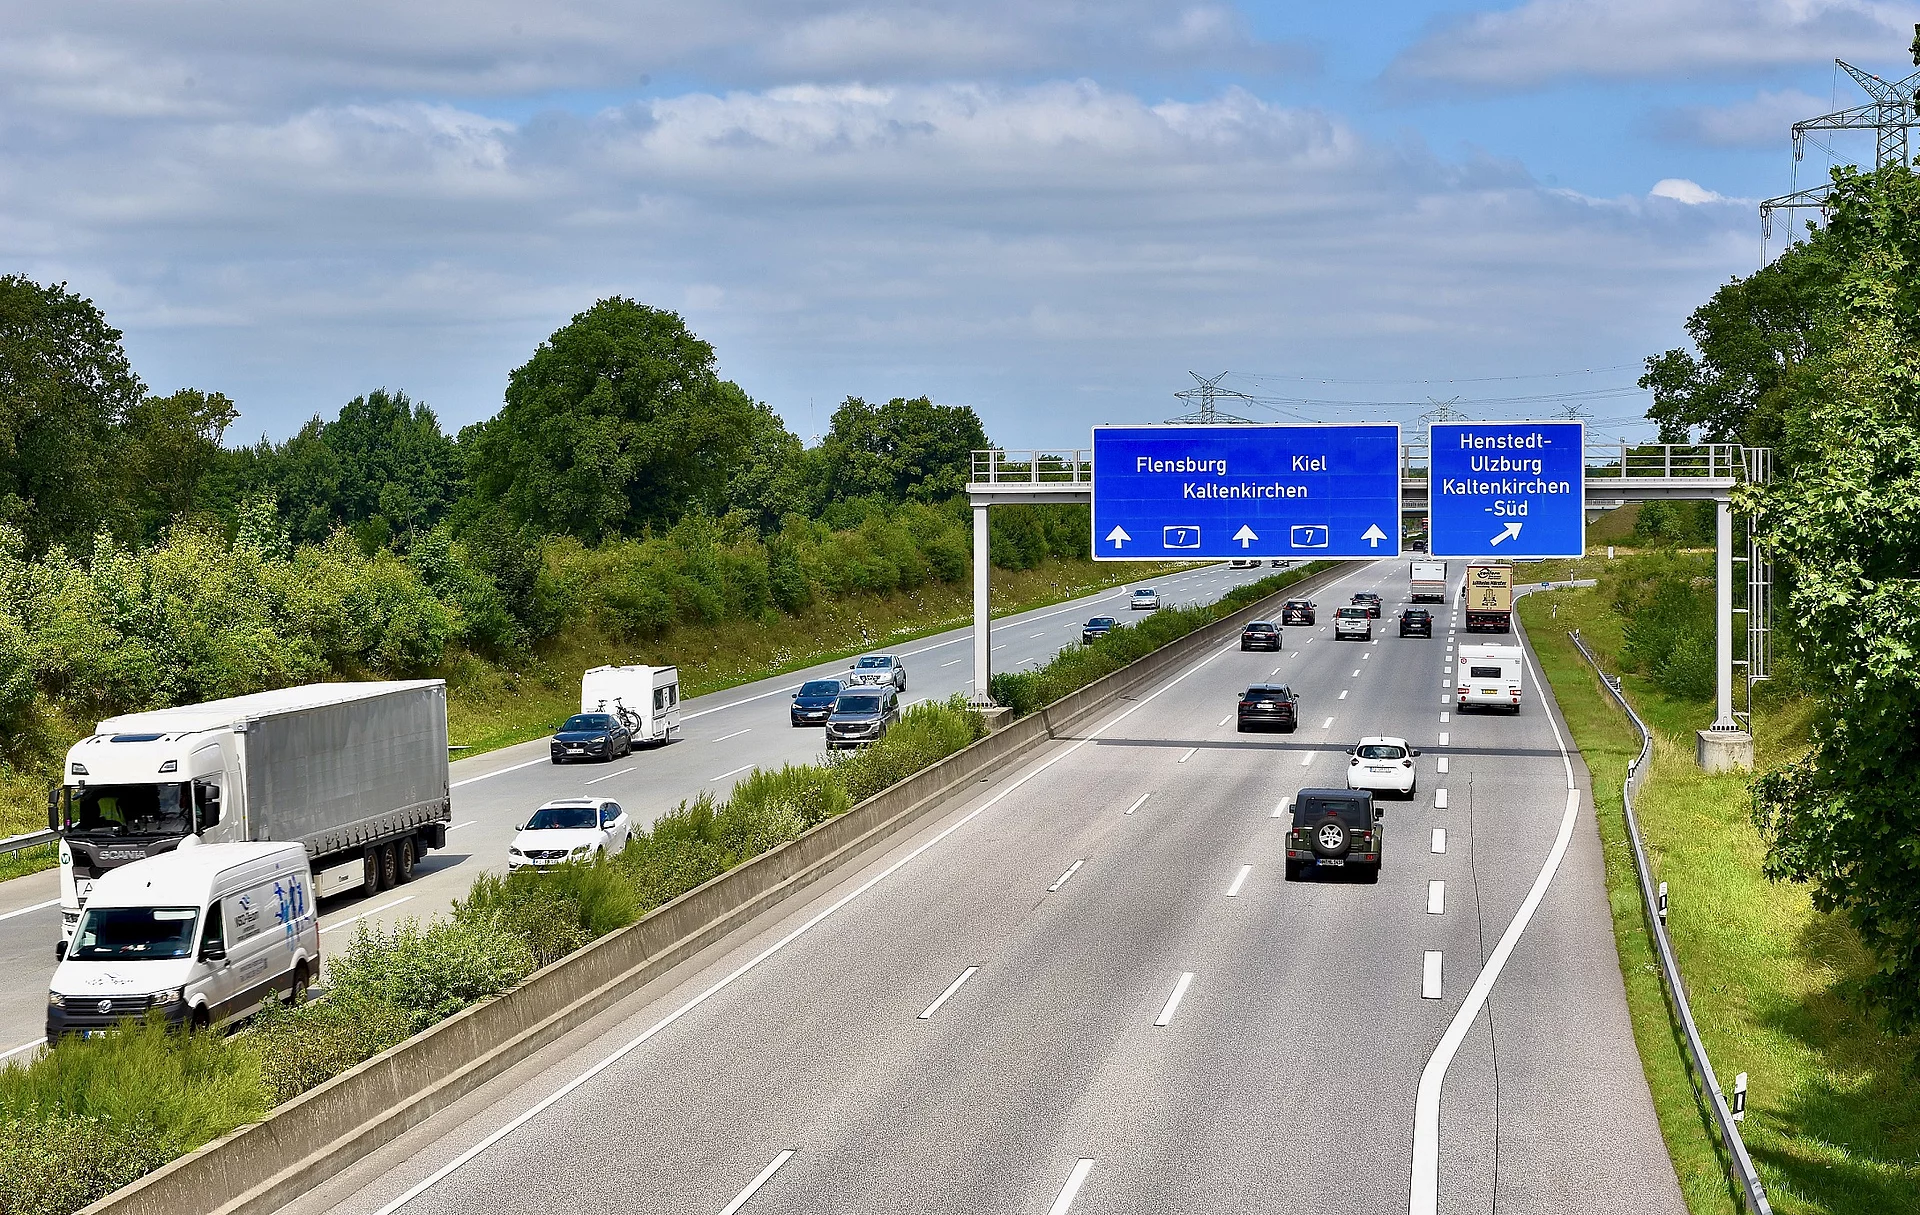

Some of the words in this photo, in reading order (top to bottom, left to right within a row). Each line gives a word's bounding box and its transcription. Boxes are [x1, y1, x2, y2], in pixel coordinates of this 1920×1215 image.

[1460, 433, 1552, 449] Henstedt-
[1136, 456, 1227, 476] Flensburg
[1292, 455, 1328, 472] Kiel
[1470, 456, 1543, 475] Ulzburg
[1183, 482, 1309, 499] Kaltenkirchen
[1443, 478, 1571, 495] Kaltenkirchen
[1484, 499, 1529, 517] -Süd
[1177, 530, 1187, 544] 7
[1305, 529, 1315, 544] 7
[98, 850, 147, 860] SCANIA
